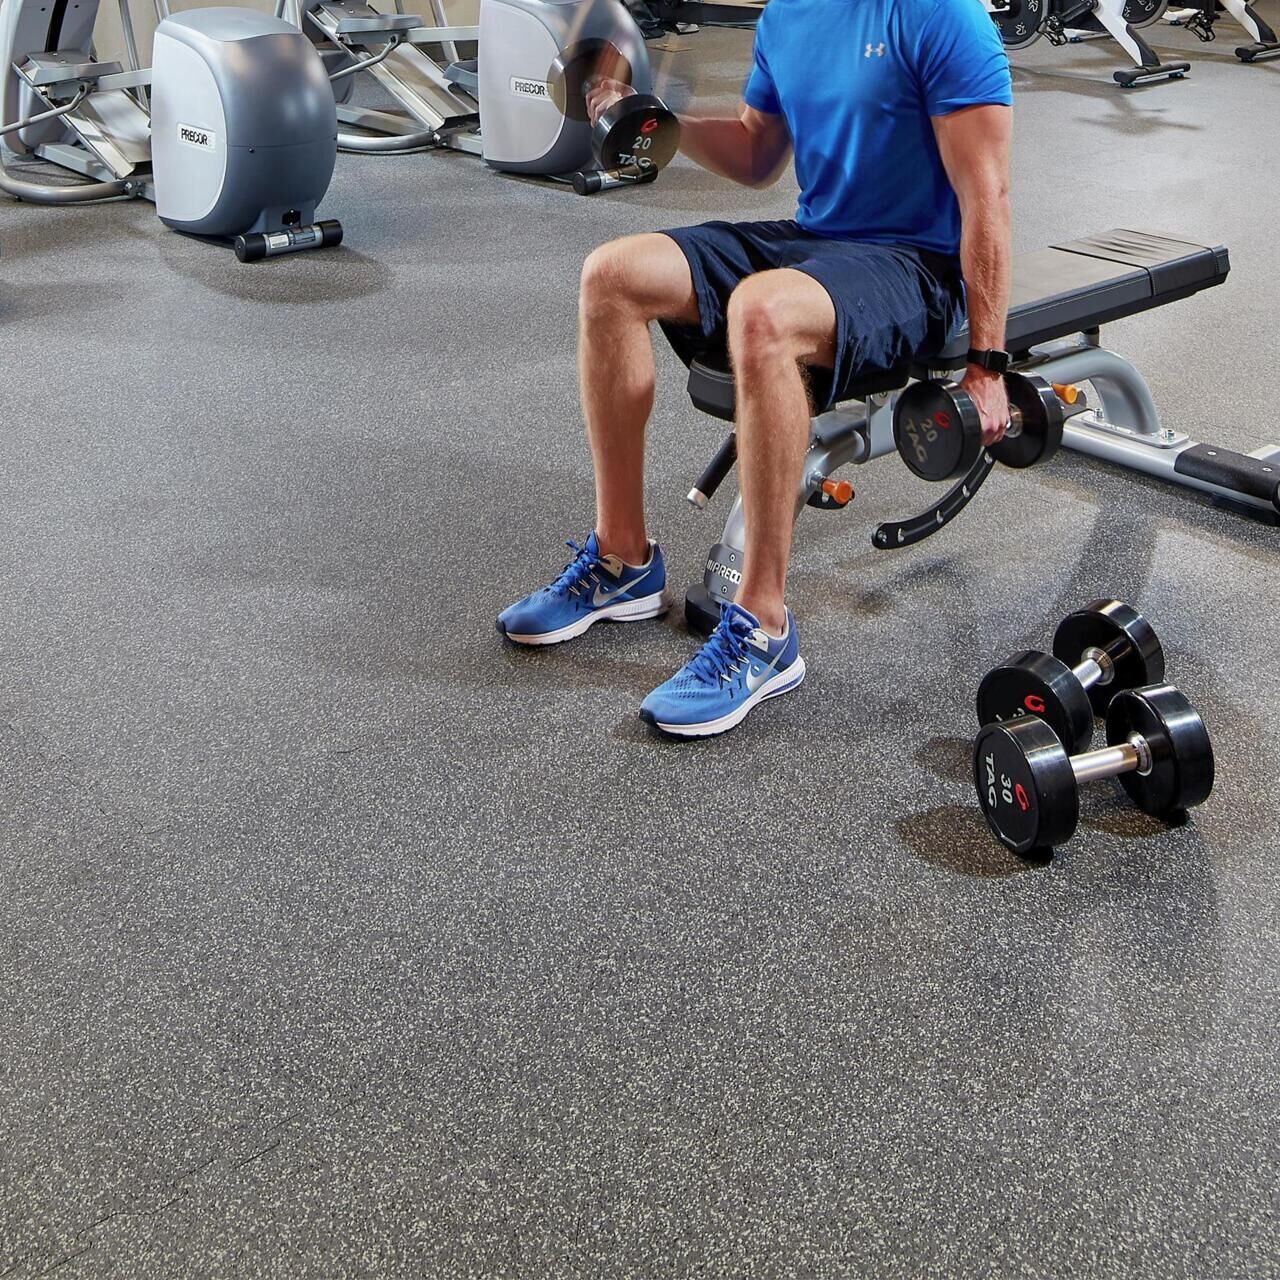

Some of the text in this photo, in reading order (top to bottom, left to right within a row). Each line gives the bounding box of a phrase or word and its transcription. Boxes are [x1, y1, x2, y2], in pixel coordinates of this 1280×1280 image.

[514, 81, 545, 96] PRECOR
[181, 128, 208, 145] PRECOR
[632, 135, 652, 150] 20
[619, 153, 652, 168] TAG
[905, 417, 929, 463] TAG
[920, 418, 938, 443] 20
[985, 752, 998, 809] TAG
[1000, 773, 1013, 805] 30
